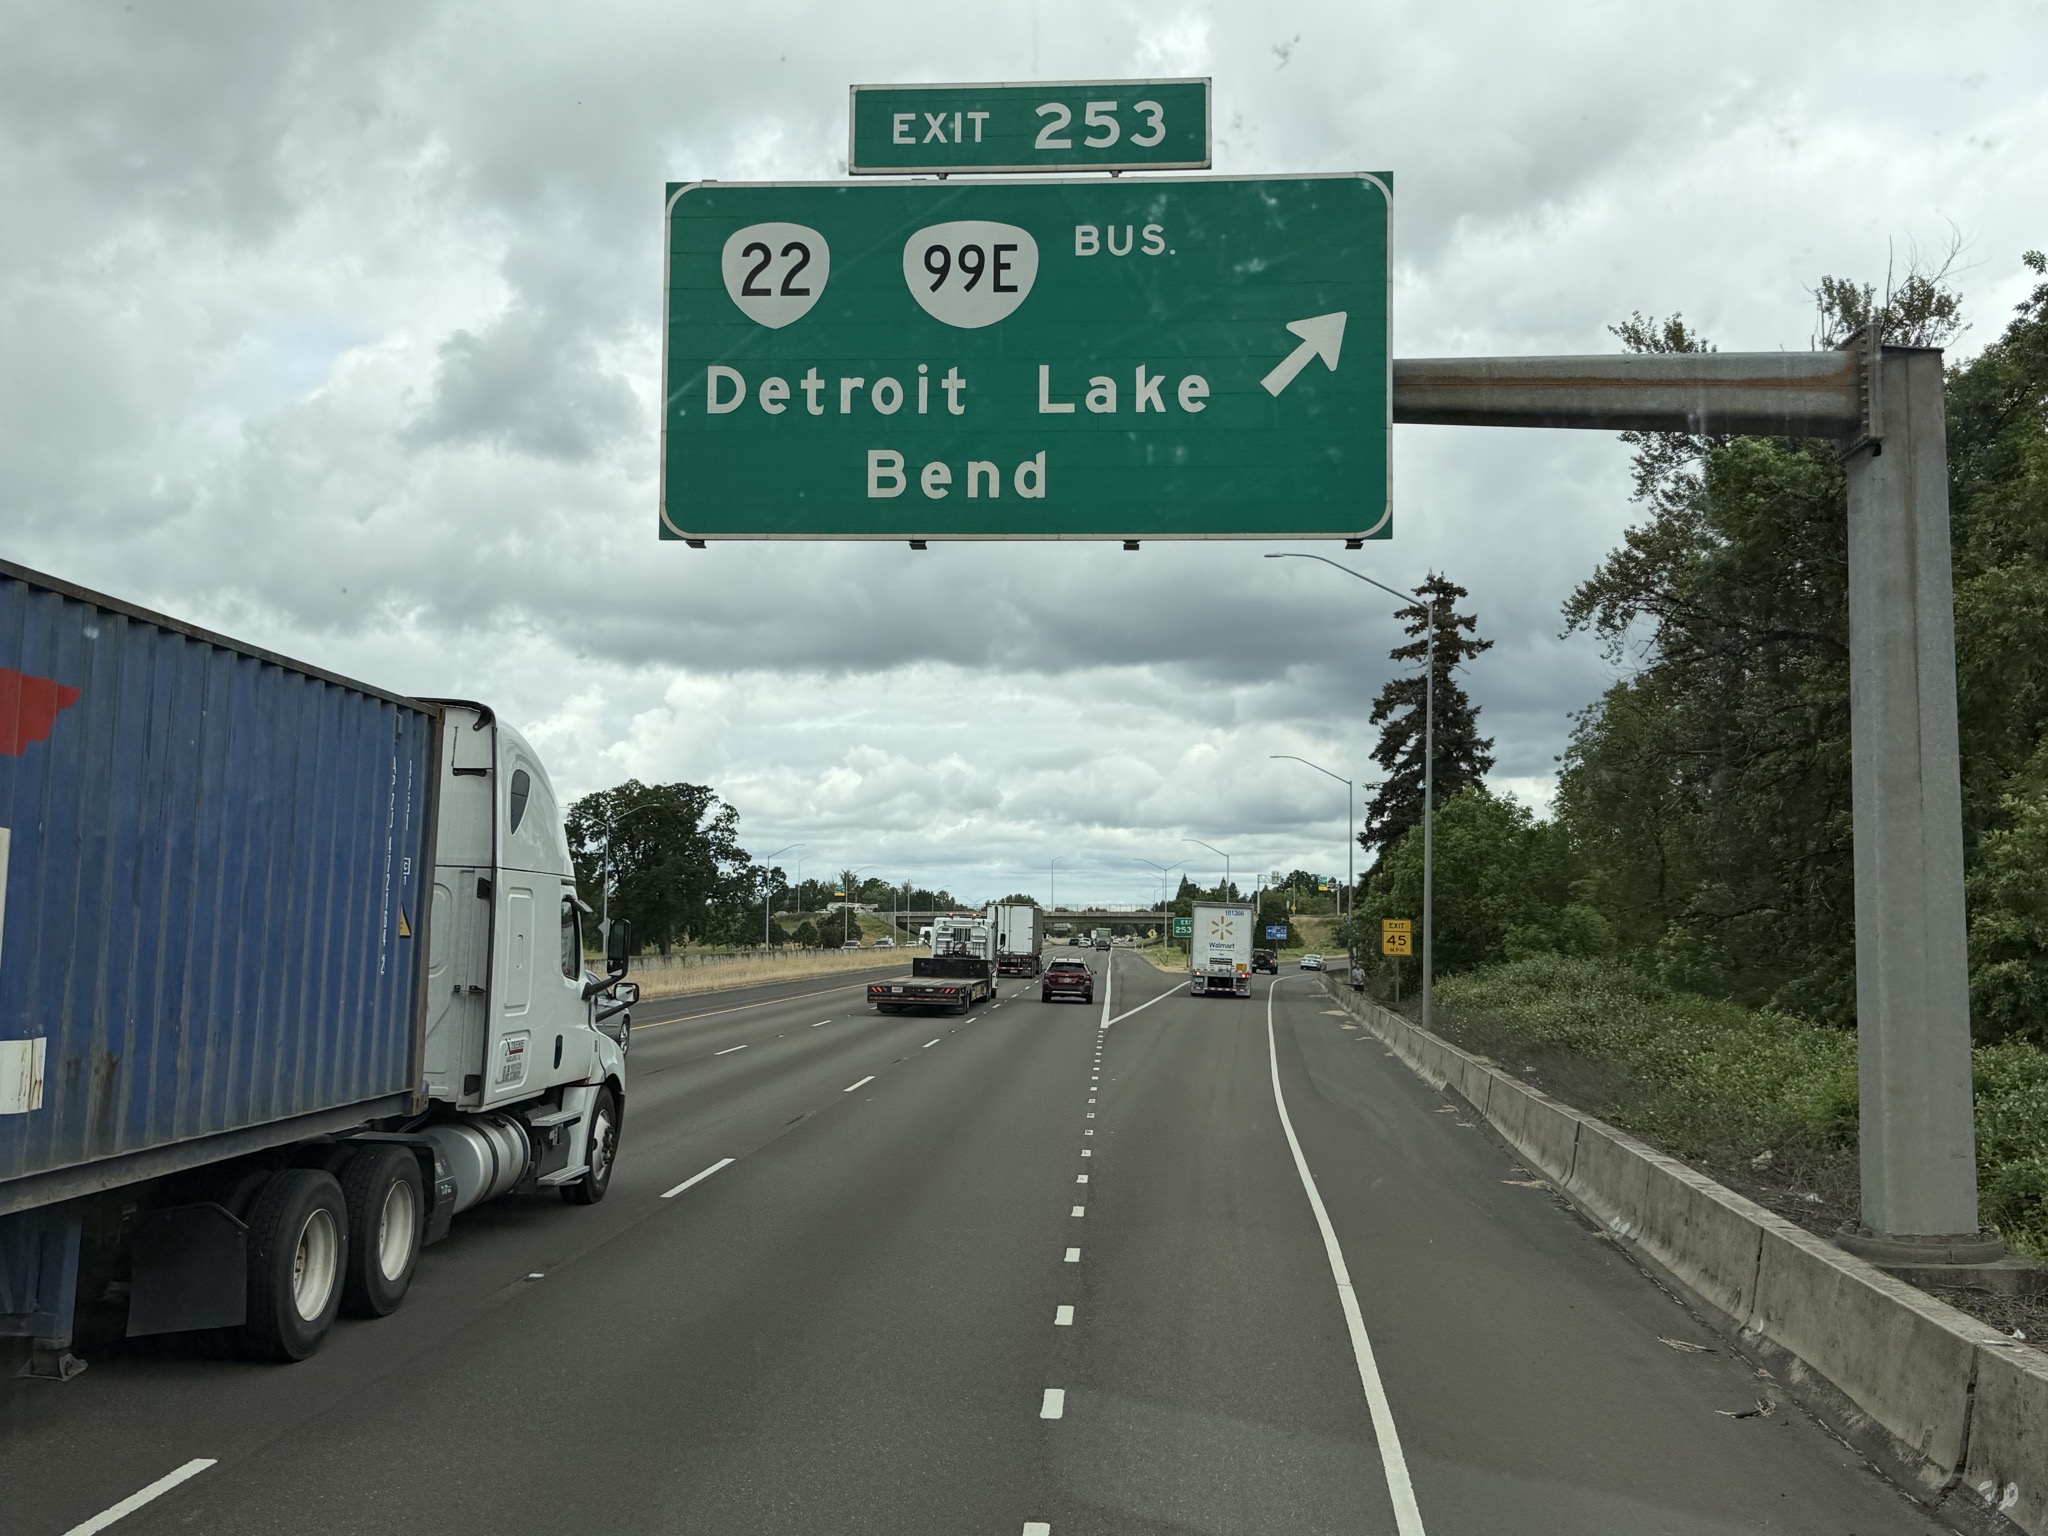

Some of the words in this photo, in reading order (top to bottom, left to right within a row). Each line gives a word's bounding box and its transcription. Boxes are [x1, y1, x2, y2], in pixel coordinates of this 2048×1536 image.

[893, 111, 990, 144] EXIT
[1034, 100, 1167, 150] 253
[1075, 223, 1177, 257] BUS.
[741, 241, 811, 297] 22
[923, 243, 1019, 294] 99E
[707, 363, 967, 416] Detroit
[1038, 364, 1211, 414] Lake
[867, 449, 1047, 499] Bend
[1175, 926, 1192, 934] 253
[1209, 942, 1236, 950] Walmart
[1386, 934, 1407, 946] 45
